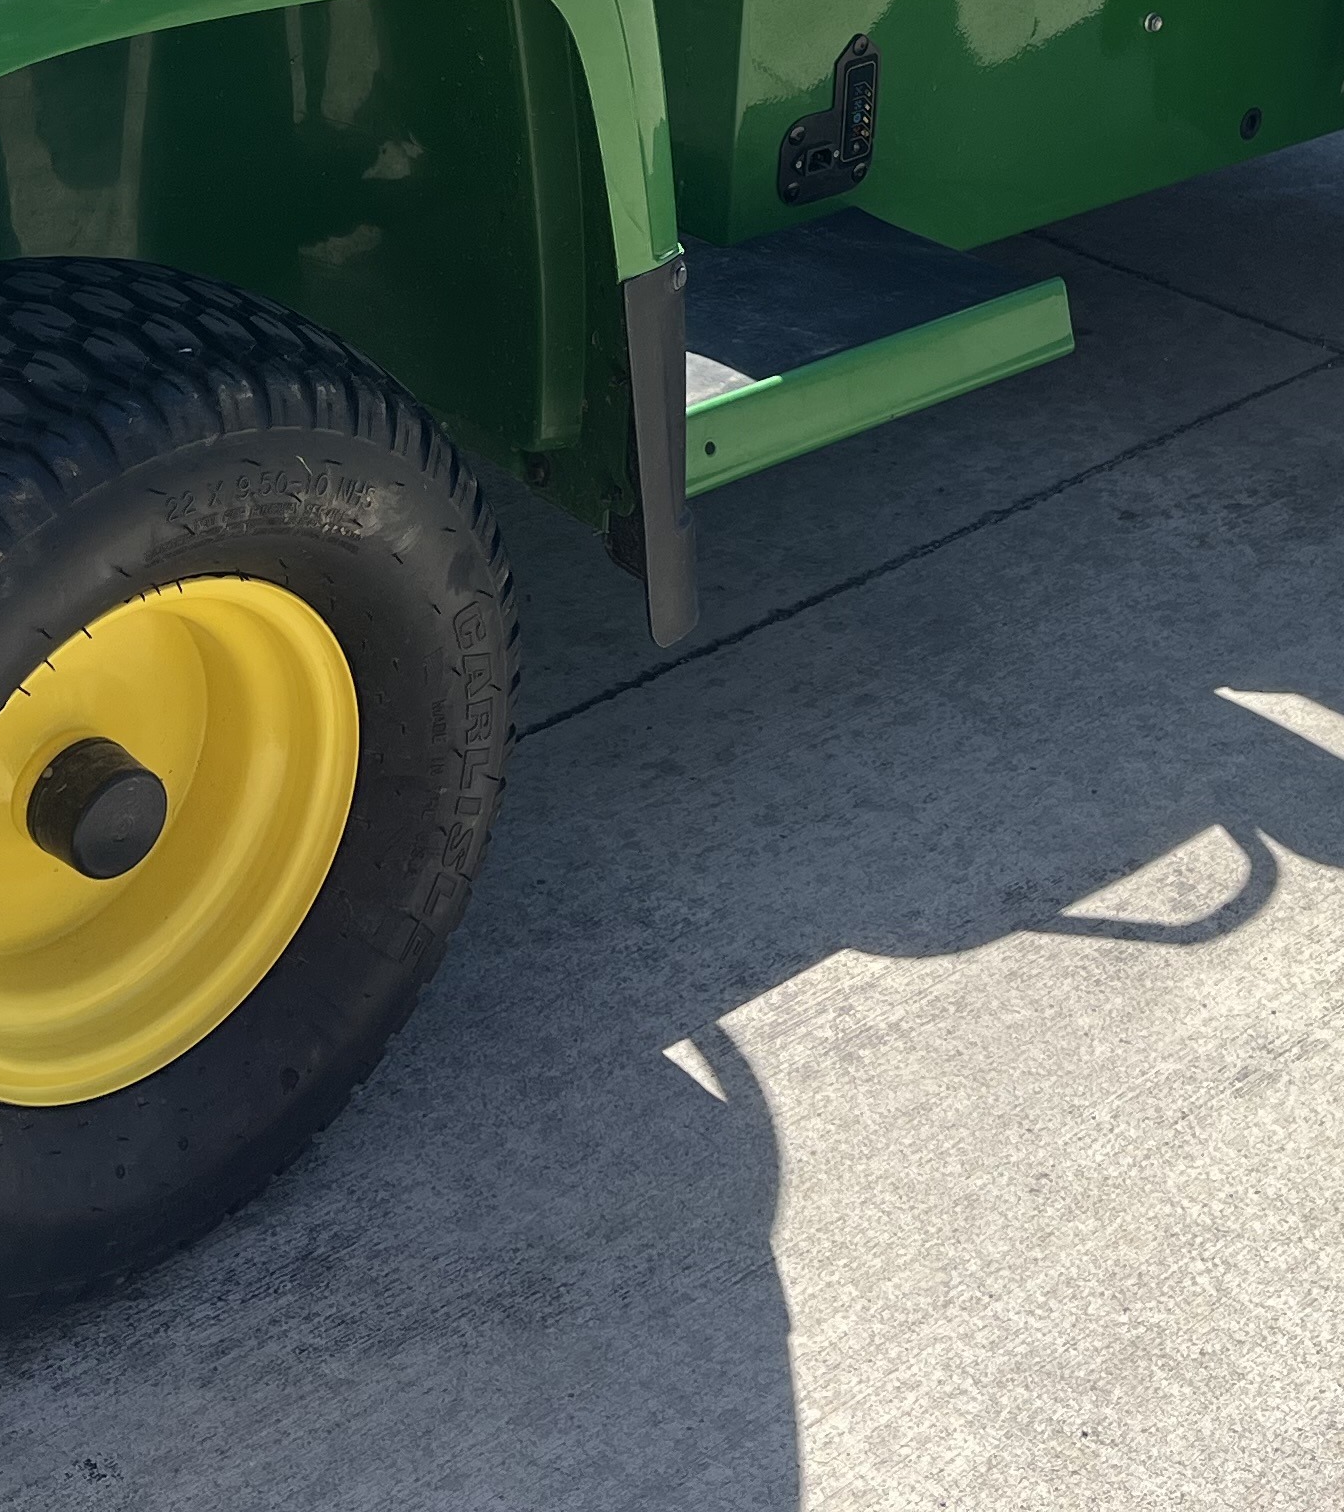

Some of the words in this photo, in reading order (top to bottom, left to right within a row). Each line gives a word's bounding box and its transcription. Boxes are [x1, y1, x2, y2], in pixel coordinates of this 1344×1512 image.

[165, 490, 197, 523] 22
[236, 471, 330, 501] 9.50-10
[399, 600, 494, 974] CARLISLE
